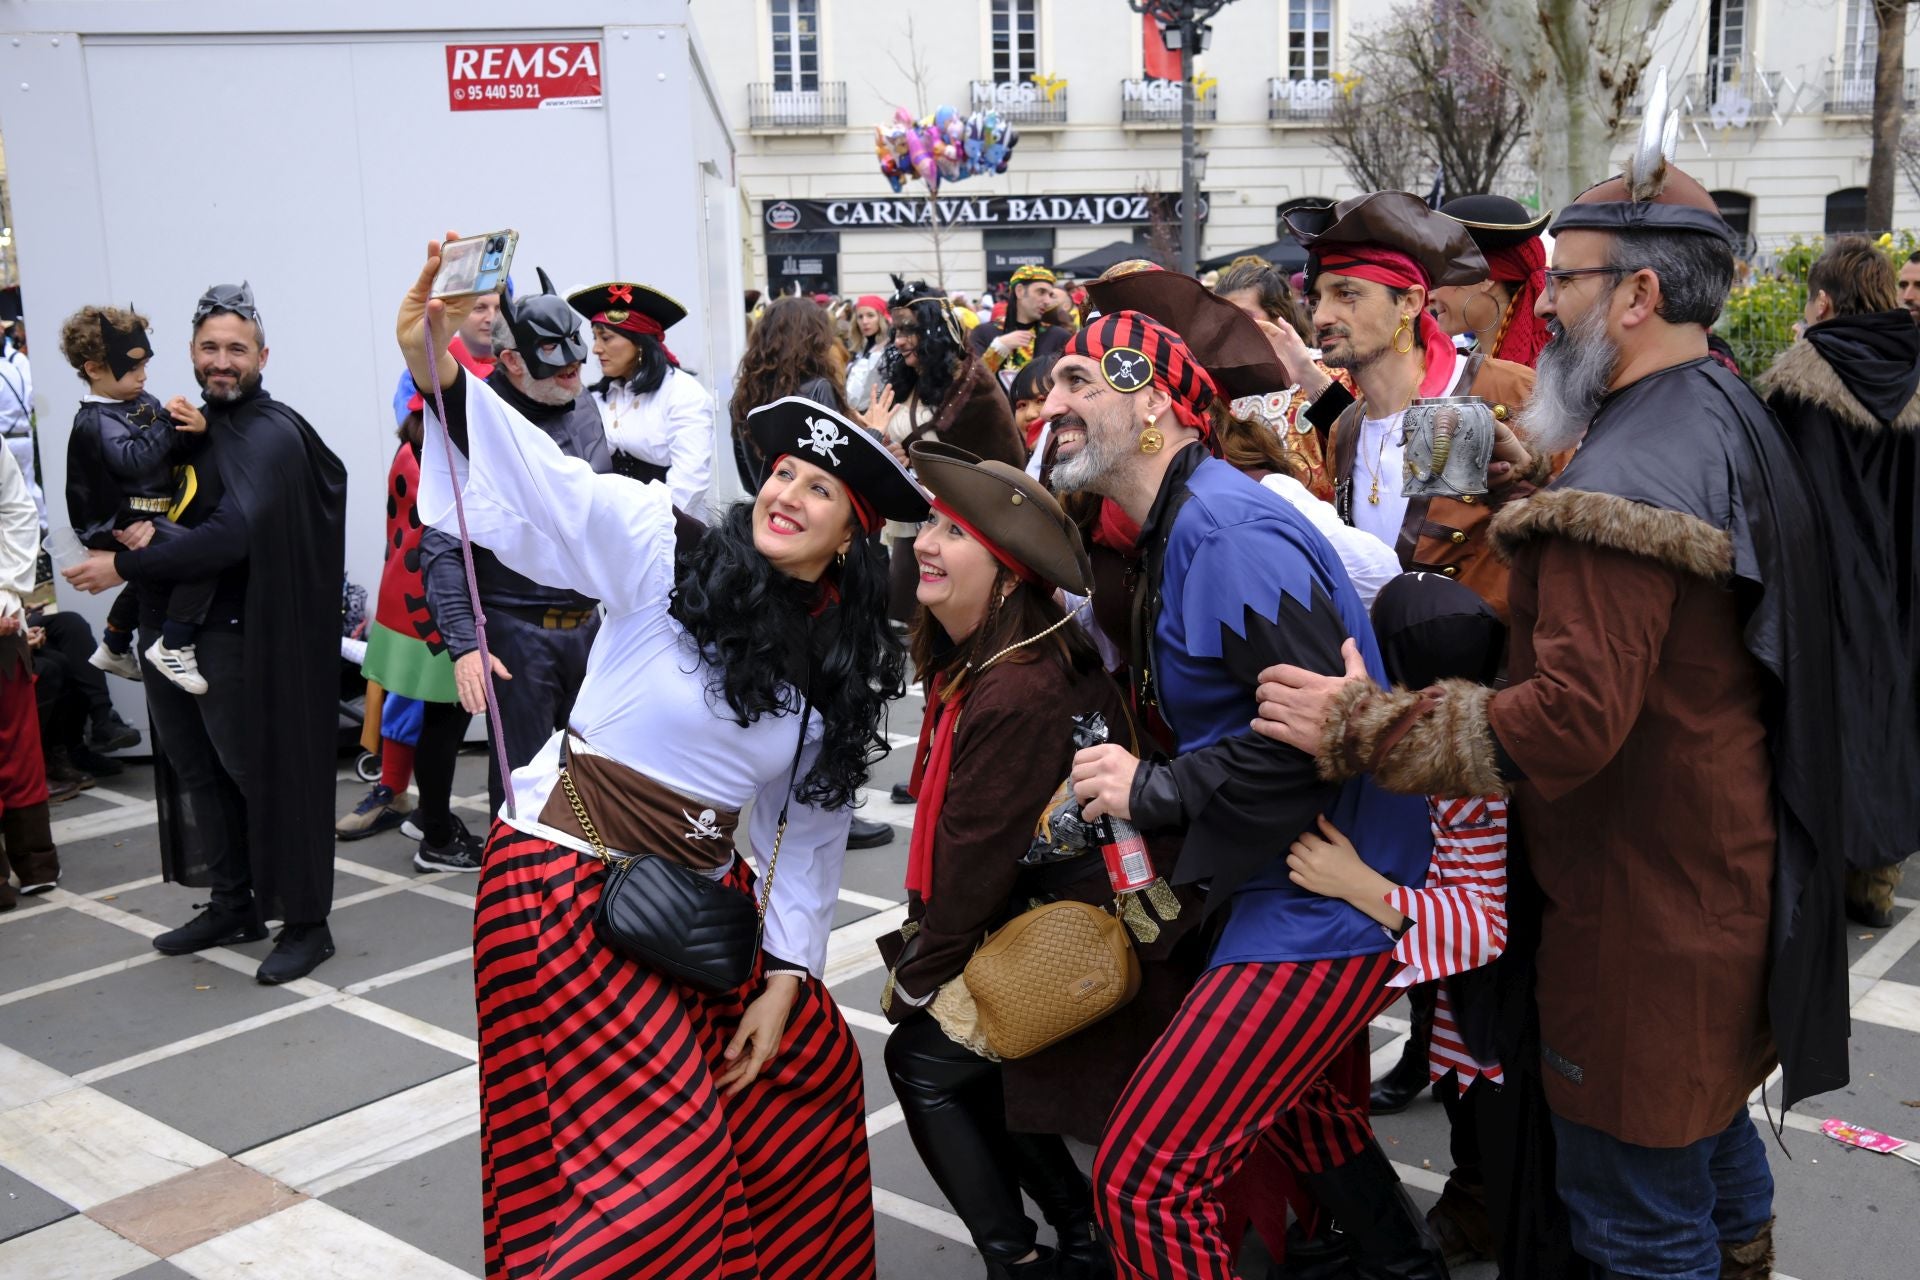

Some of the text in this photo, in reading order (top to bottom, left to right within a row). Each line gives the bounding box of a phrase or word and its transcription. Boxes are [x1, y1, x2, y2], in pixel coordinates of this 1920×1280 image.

[452, 46, 598, 80] REMSA
[468, 83, 540, 100] 95 440 50 21
[826, 199, 998, 225] CARNAVAL
[1007, 197, 1150, 224] BADAJOZ
